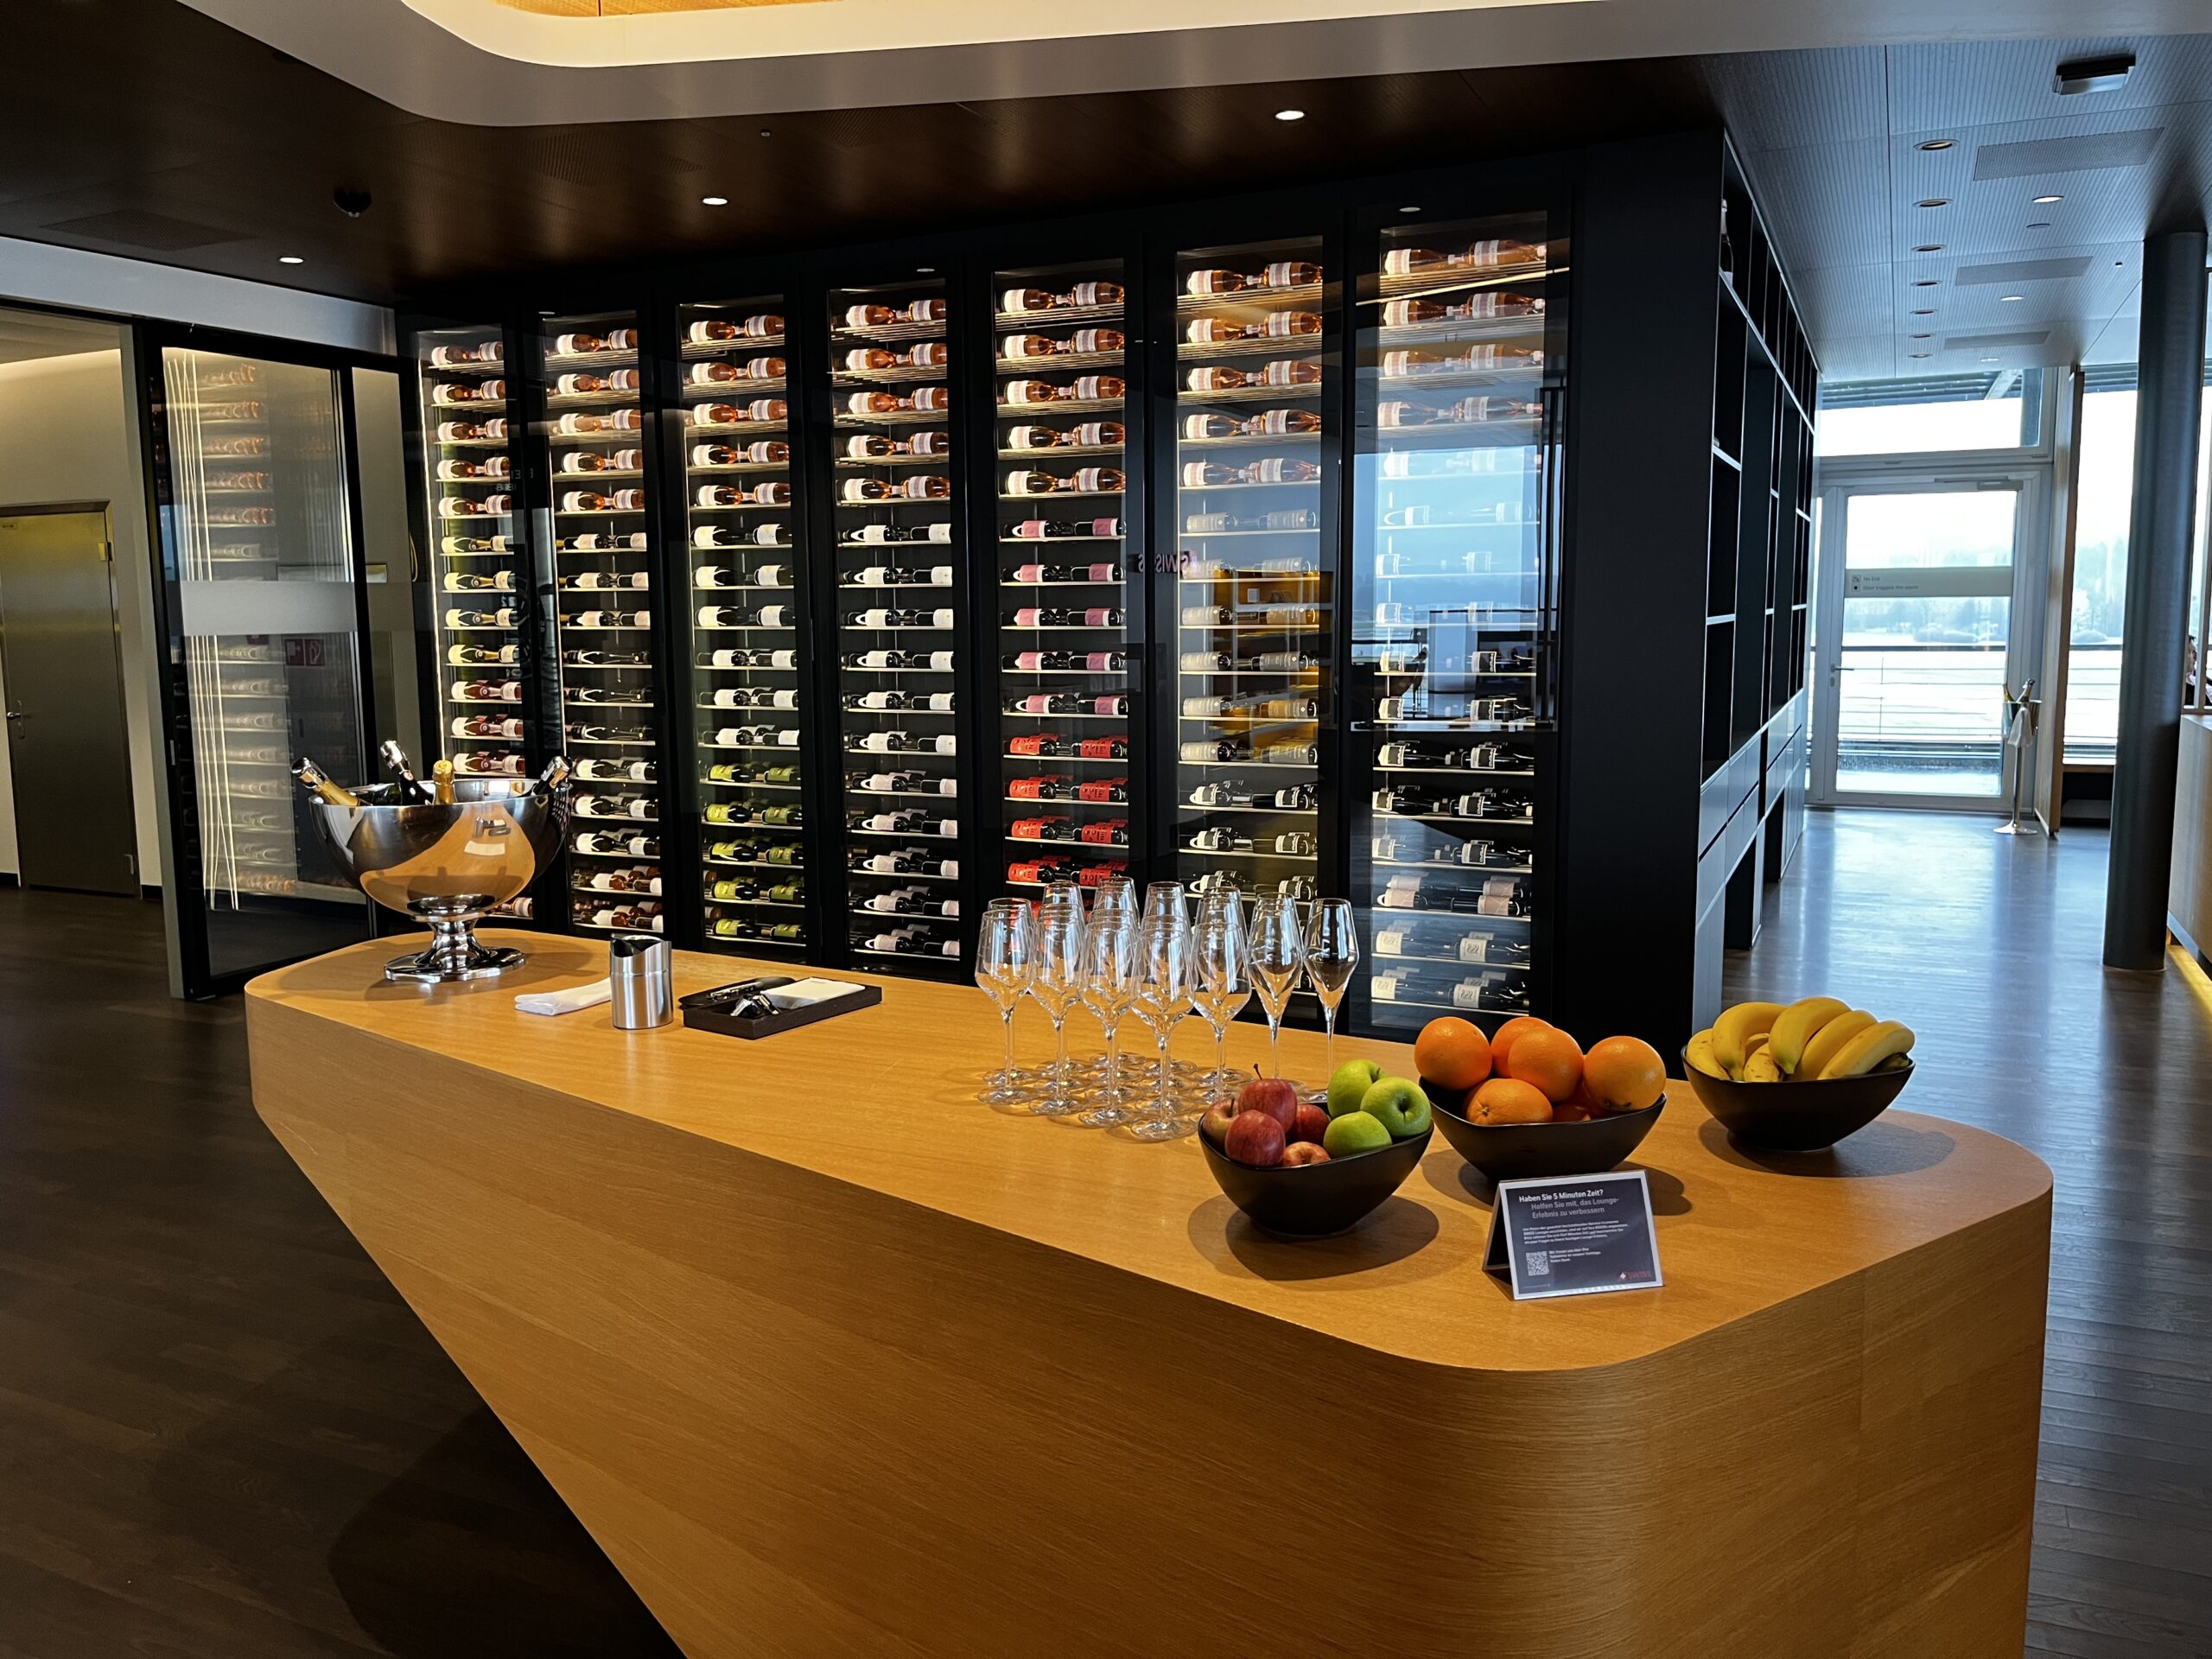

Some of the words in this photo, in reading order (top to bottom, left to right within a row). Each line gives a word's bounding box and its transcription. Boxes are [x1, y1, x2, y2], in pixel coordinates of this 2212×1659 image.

[1559, 1191, 1586, 1199] Minuten
[1531, 1202, 1553, 1211] Helfen
[1532, 1211, 1559, 1219] Erlebnis
[1568, 1207, 1605, 1216] verbessern
